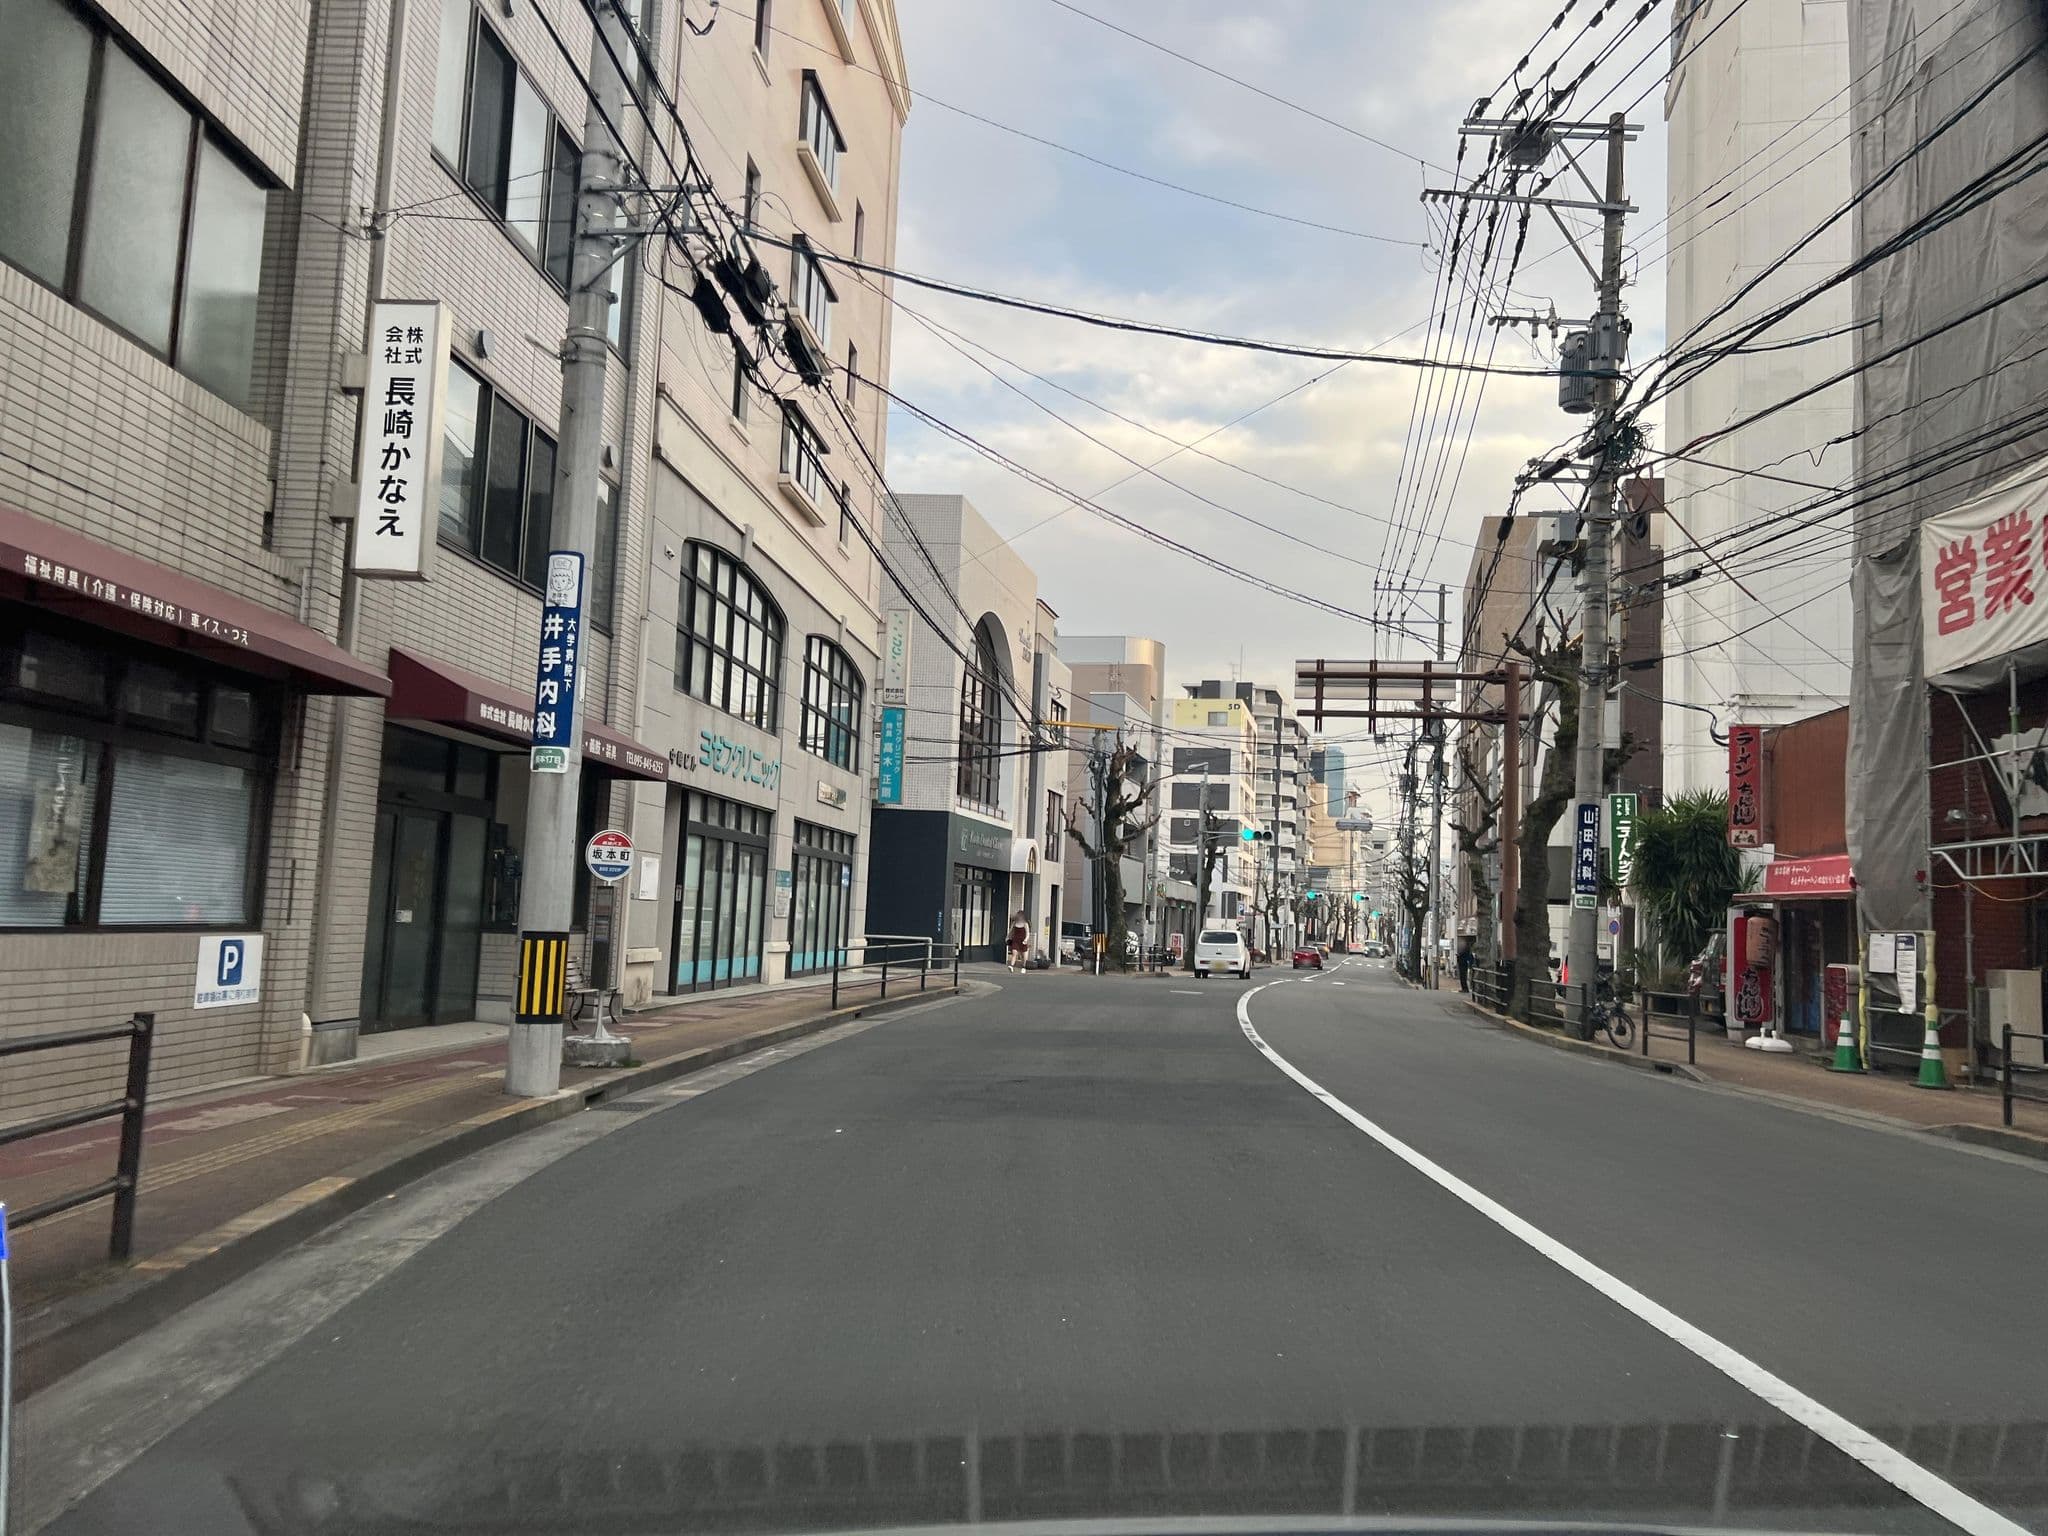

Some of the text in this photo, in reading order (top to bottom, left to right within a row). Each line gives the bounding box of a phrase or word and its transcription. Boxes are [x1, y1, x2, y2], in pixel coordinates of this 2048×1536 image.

[384, 325, 403, 365] 会社
[406, 325, 425, 365] 株式
[375, 375, 416, 538] 長崎かなえ
[1934, 508, 2048, 637] 営業
[536, 613, 564, 740] 井手内科
[563, 617, 577, 693] 大学病院下
[699, 729, 780, 791] ヨゼフクリニック
[1735, 732, 1755, 777] ラーメン
[592, 849, 631, 861] 坂本町
[1582, 809, 1594, 881] 山田内科
